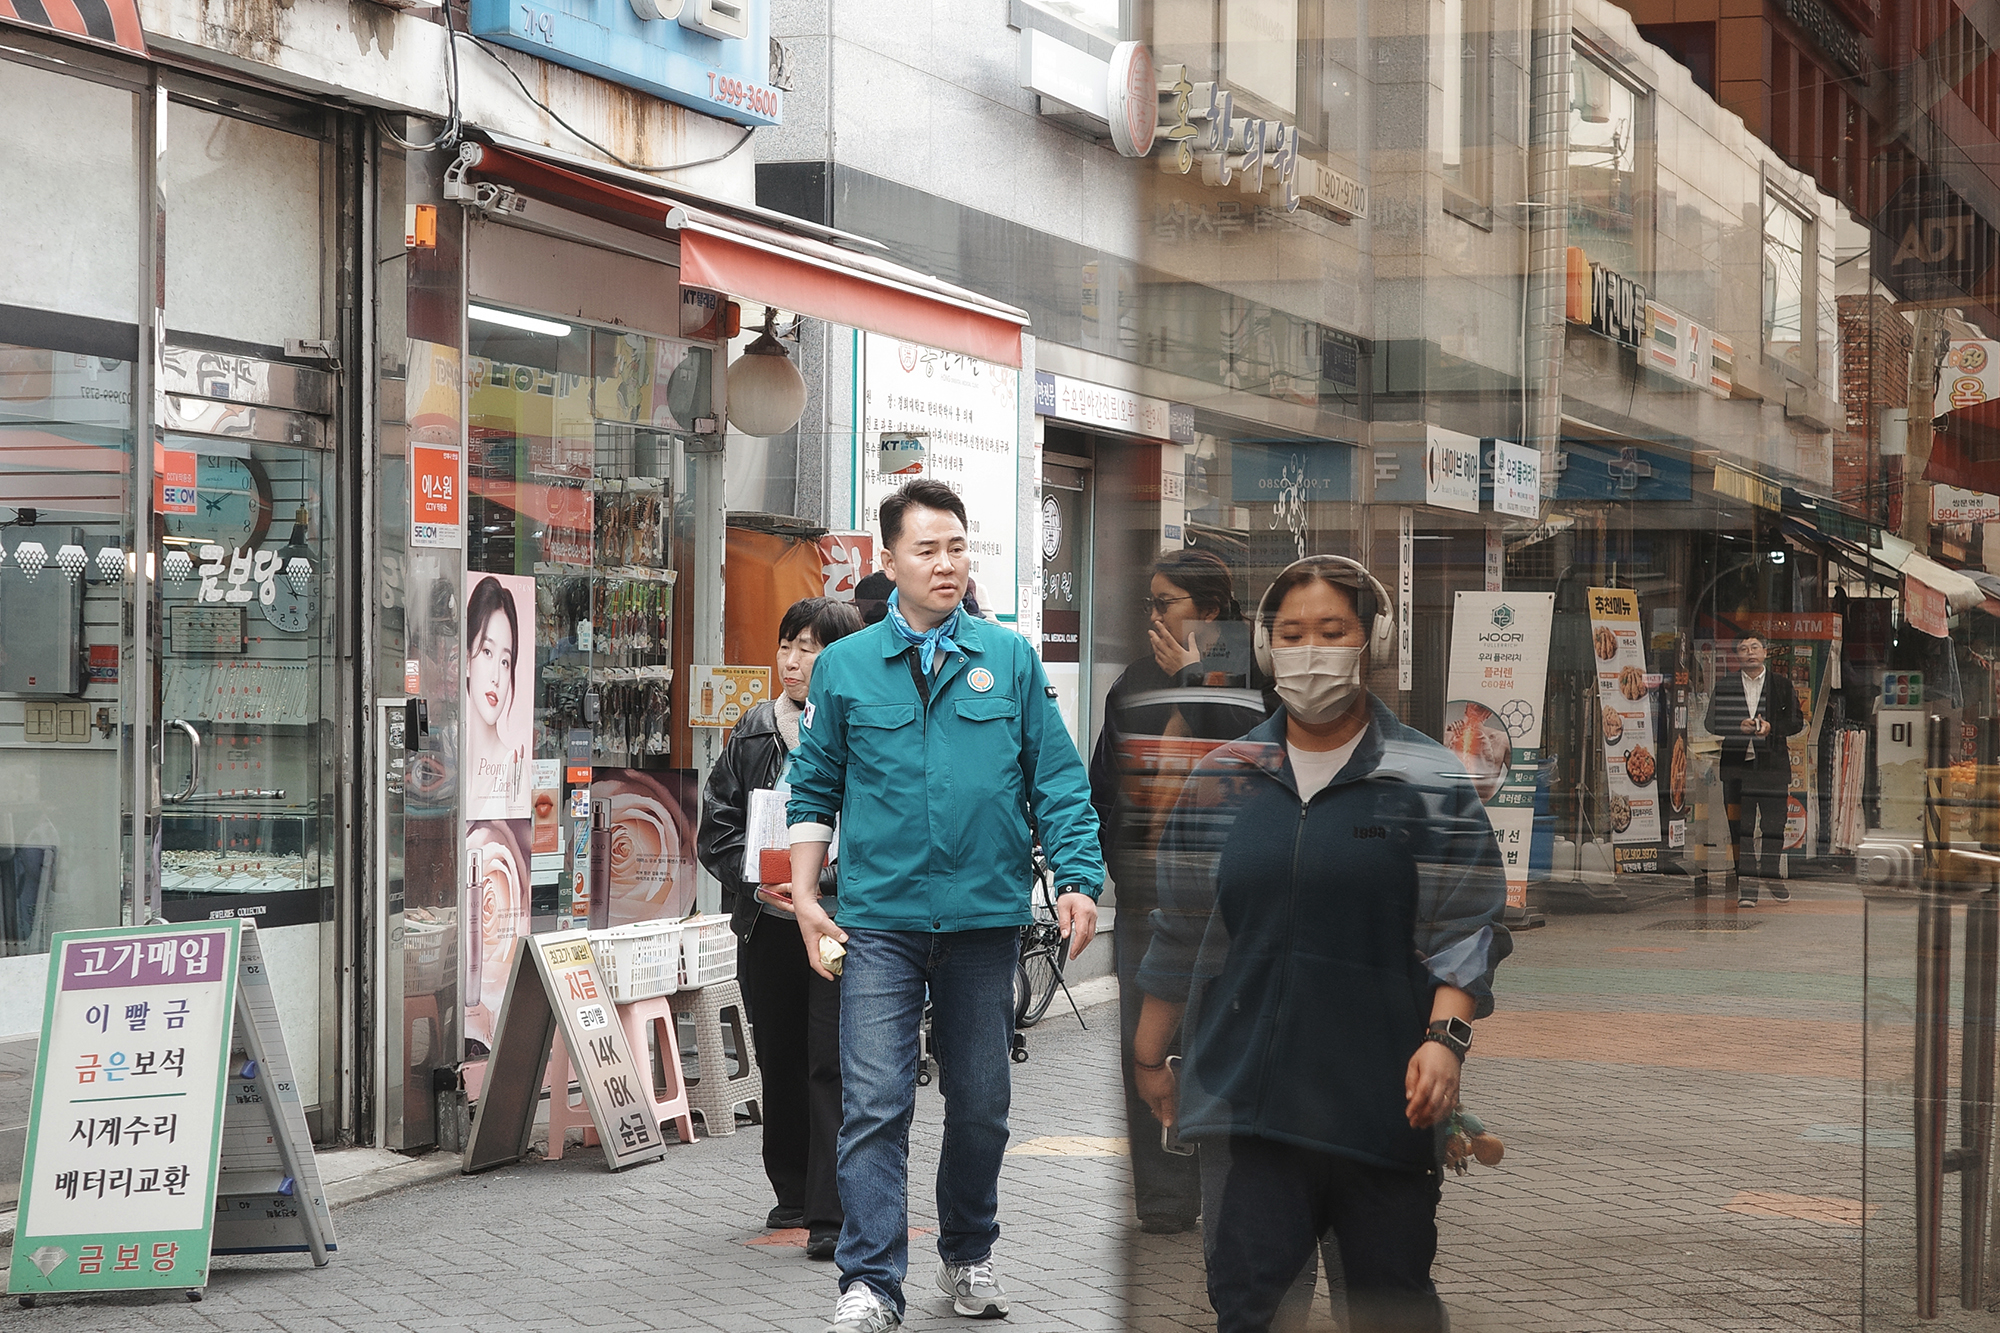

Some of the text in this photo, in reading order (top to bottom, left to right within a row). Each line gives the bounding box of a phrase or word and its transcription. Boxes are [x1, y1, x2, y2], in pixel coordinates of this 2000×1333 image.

[707, 71, 779, 118] T.999-3600
[1317, 167, 1366, 212] T.907-9700
[1891, 215, 1976, 265] ADT
[164, 487, 195, 504] SECOM
[421, 475, 453, 500] 에스원
[1937, 508, 1996, 520] 994-5955
[415, 526, 437, 538] SECOM
[198, 545, 283, 605] 금보당
[1595, 596, 1631, 616] 추천메뉴
[1479, 632, 1524, 642] WOORI
[1794, 620, 1823, 633] ATM
[1484, 667, 1513, 679] 플러렌
[477, 758, 507, 776] Peony
[73, 937, 210, 979] 고가매입
[549, 947, 571, 965] 최고가
[74, 1047, 186, 1084] 금은보석
[589, 1035, 622, 1068] 14K
[603, 1074, 635, 1109] 18K
[69, 1113, 177, 1149] 시계수리
[618, 1112, 650, 1147] 순금
[54, 1164, 191, 1202] 배터리교환
